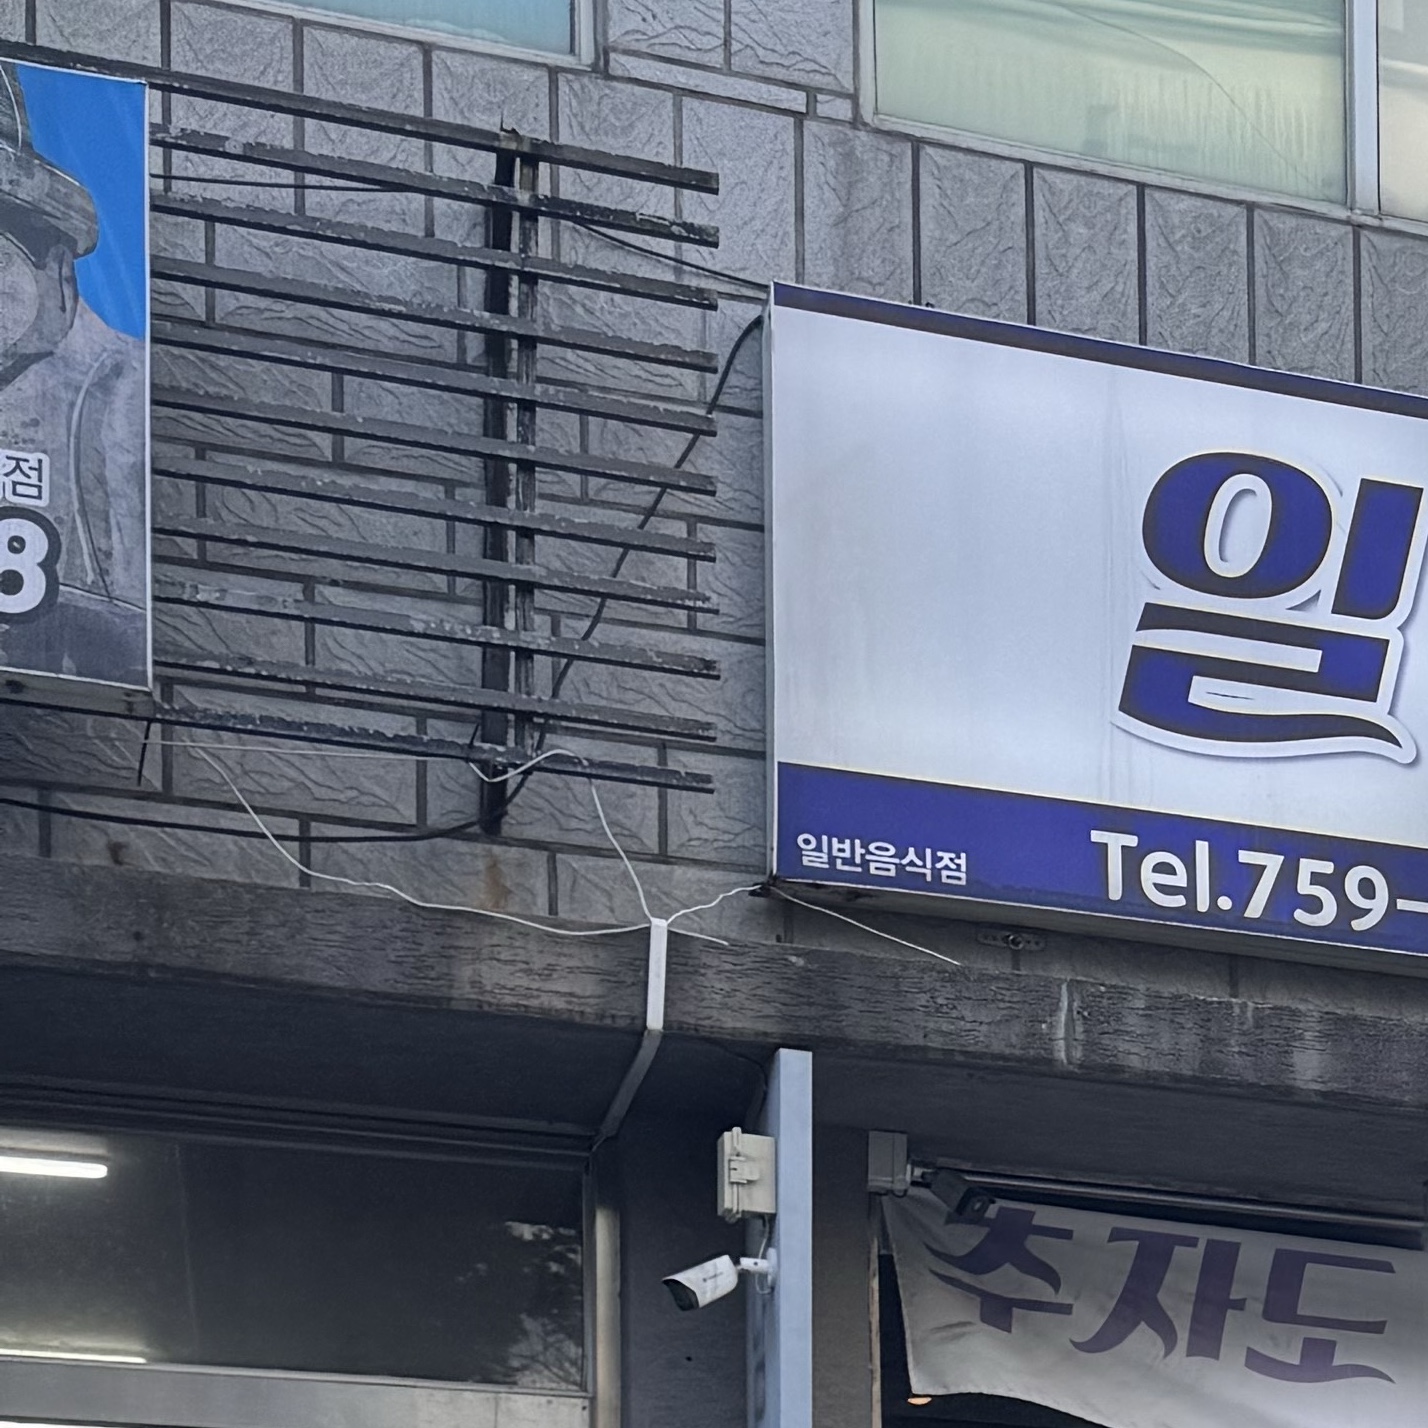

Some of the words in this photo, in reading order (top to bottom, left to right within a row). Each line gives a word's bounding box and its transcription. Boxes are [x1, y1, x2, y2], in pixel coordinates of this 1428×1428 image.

[0, 455, 43, 500] 점
[796, 831, 968, 886] 일반음식점
[924, 1208, 1397, 1384] 추자도
